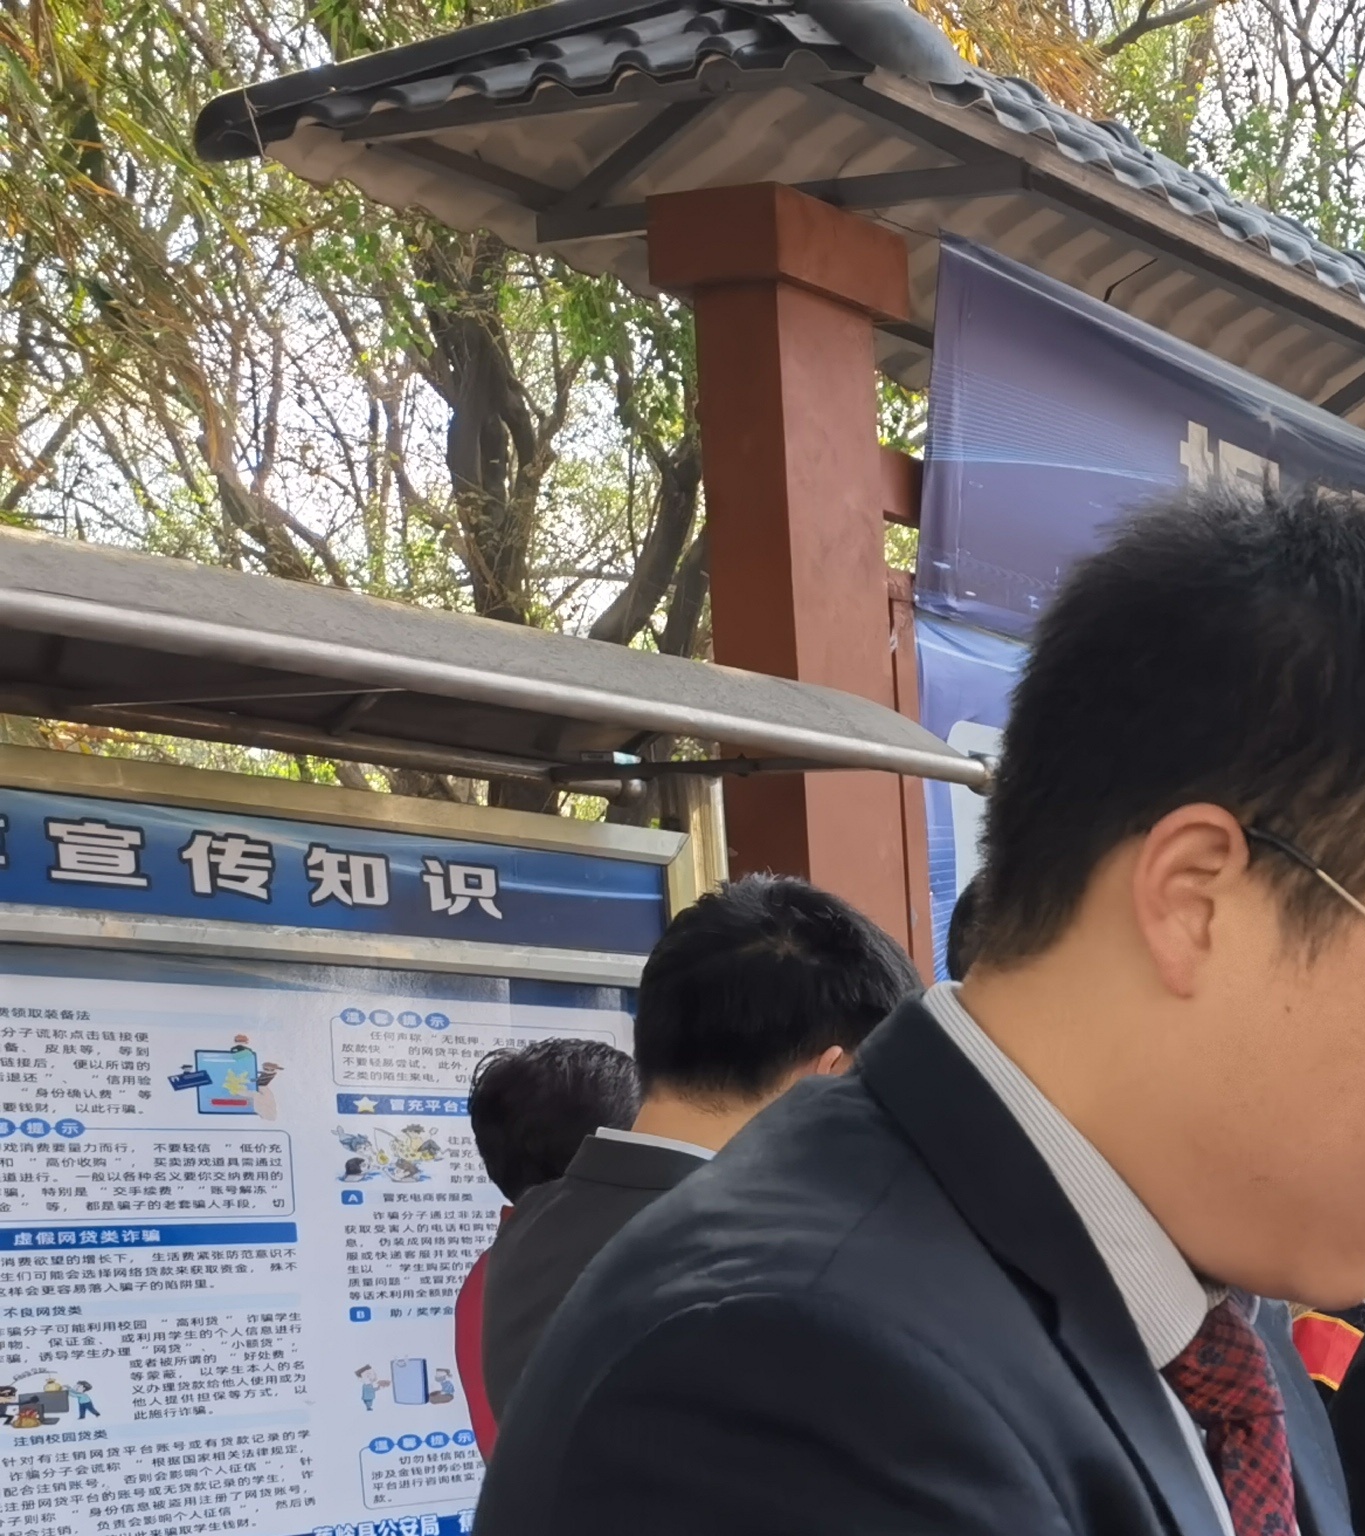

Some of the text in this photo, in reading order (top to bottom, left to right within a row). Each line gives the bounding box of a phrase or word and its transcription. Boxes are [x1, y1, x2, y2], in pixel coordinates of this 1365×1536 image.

[48, 823, 502, 918] 宣传知识
[1, 1027, 149, 1042] 分子谎称点击链接便
[383, 1193, 473, 1202] 冒充电商客服类
[373, 1211, 497, 1220] 诈骗分子通过非法途
[13, 1229, 161, 1246] 虚假网贷类诈骗
[345, 1224, 497, 1235] 获取受害人的电话和购物
[4, 1305, 82, 1318] 不良网贷类
[132, 1373, 306, 1394] 义办理贷款给他人使用或为
[133, 1406, 214, 1421] 此施行诈骗。
[13, 1429, 108, 1448] 注销校园贷类
[375, 1433, 471, 1450] 温馨提示
[0, 1470, 314, 1512] 注册网贷平台的账号或无贷款记录的学生，诈
